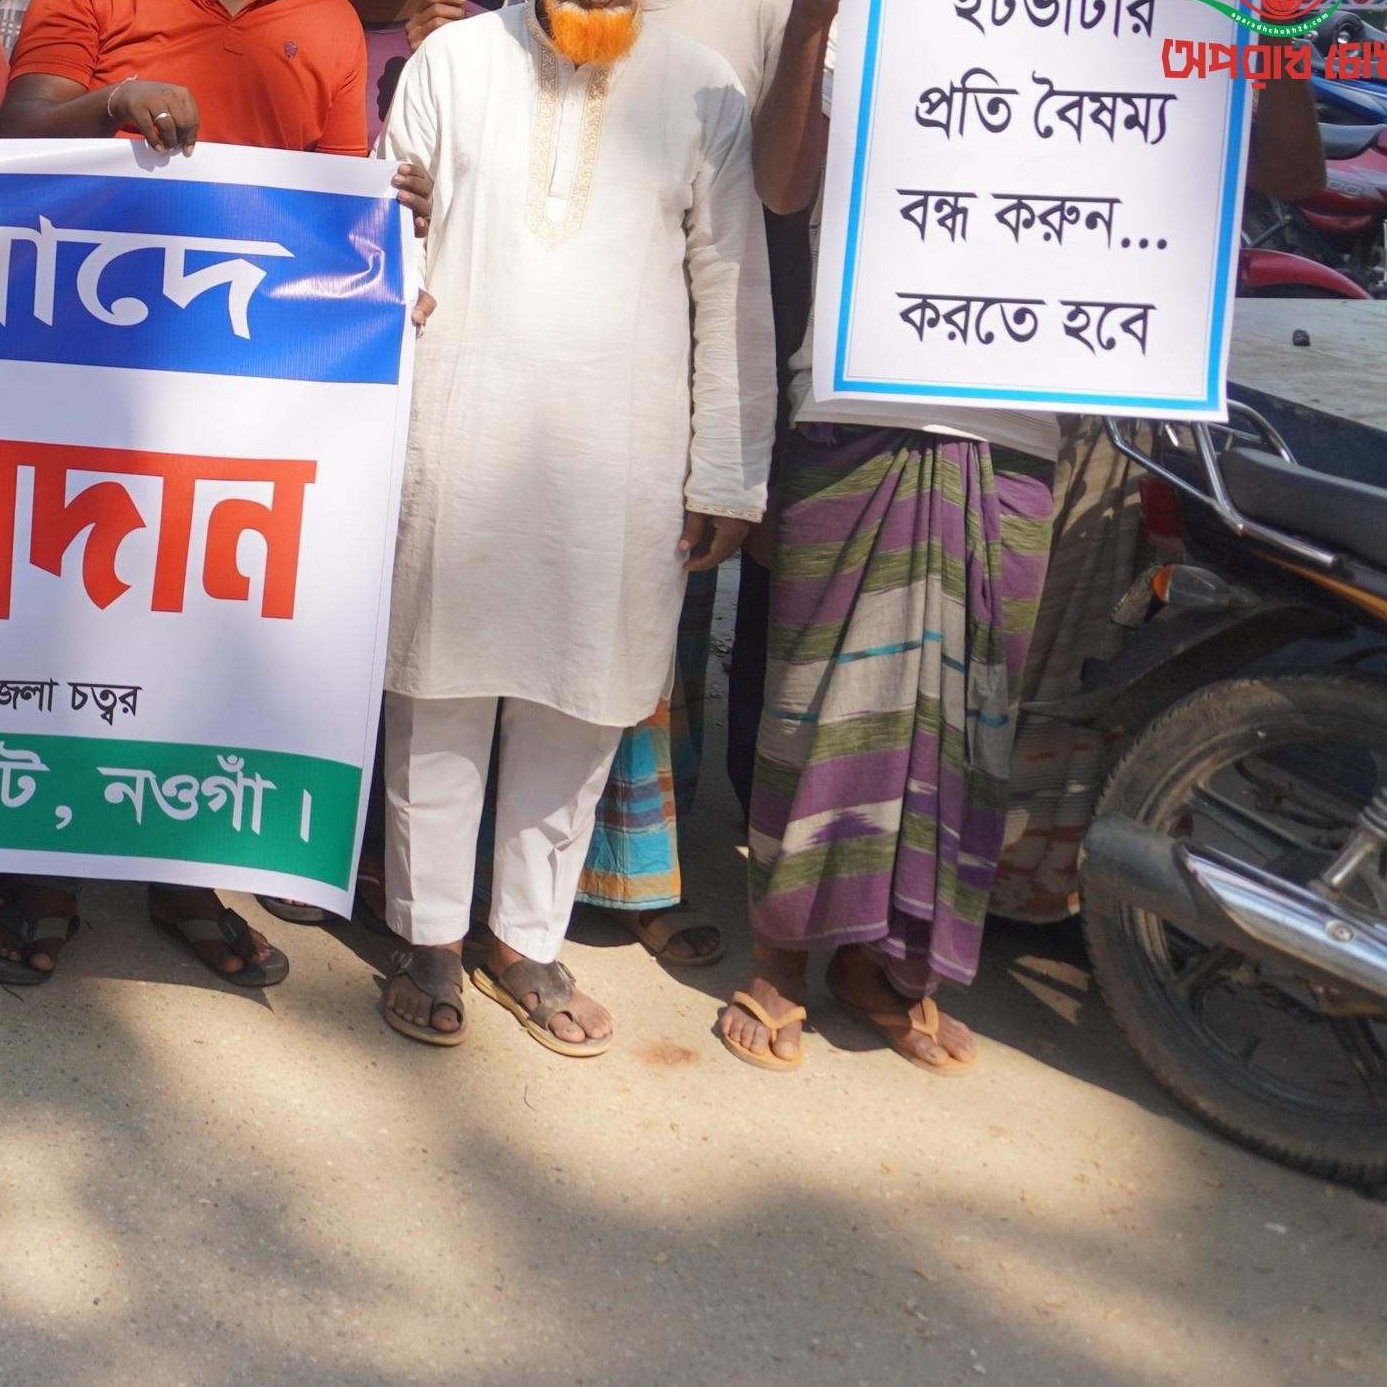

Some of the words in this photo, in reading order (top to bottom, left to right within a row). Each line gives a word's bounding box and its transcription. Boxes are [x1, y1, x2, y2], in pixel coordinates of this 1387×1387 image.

[913, 66, 1021, 142] প্রতি
[1032, 70, 1179, 149] বৈষম্য
[896, 186, 976, 246] বন্ধ
[991, 191, 1170, 254] করুন...
[896, 290, 1049, 351] করতে
[1061, 299, 1158, 360] হবে
[69, 678, 144, 727] চত্বর
[97, 753, 277, 835] নওগাঁ
